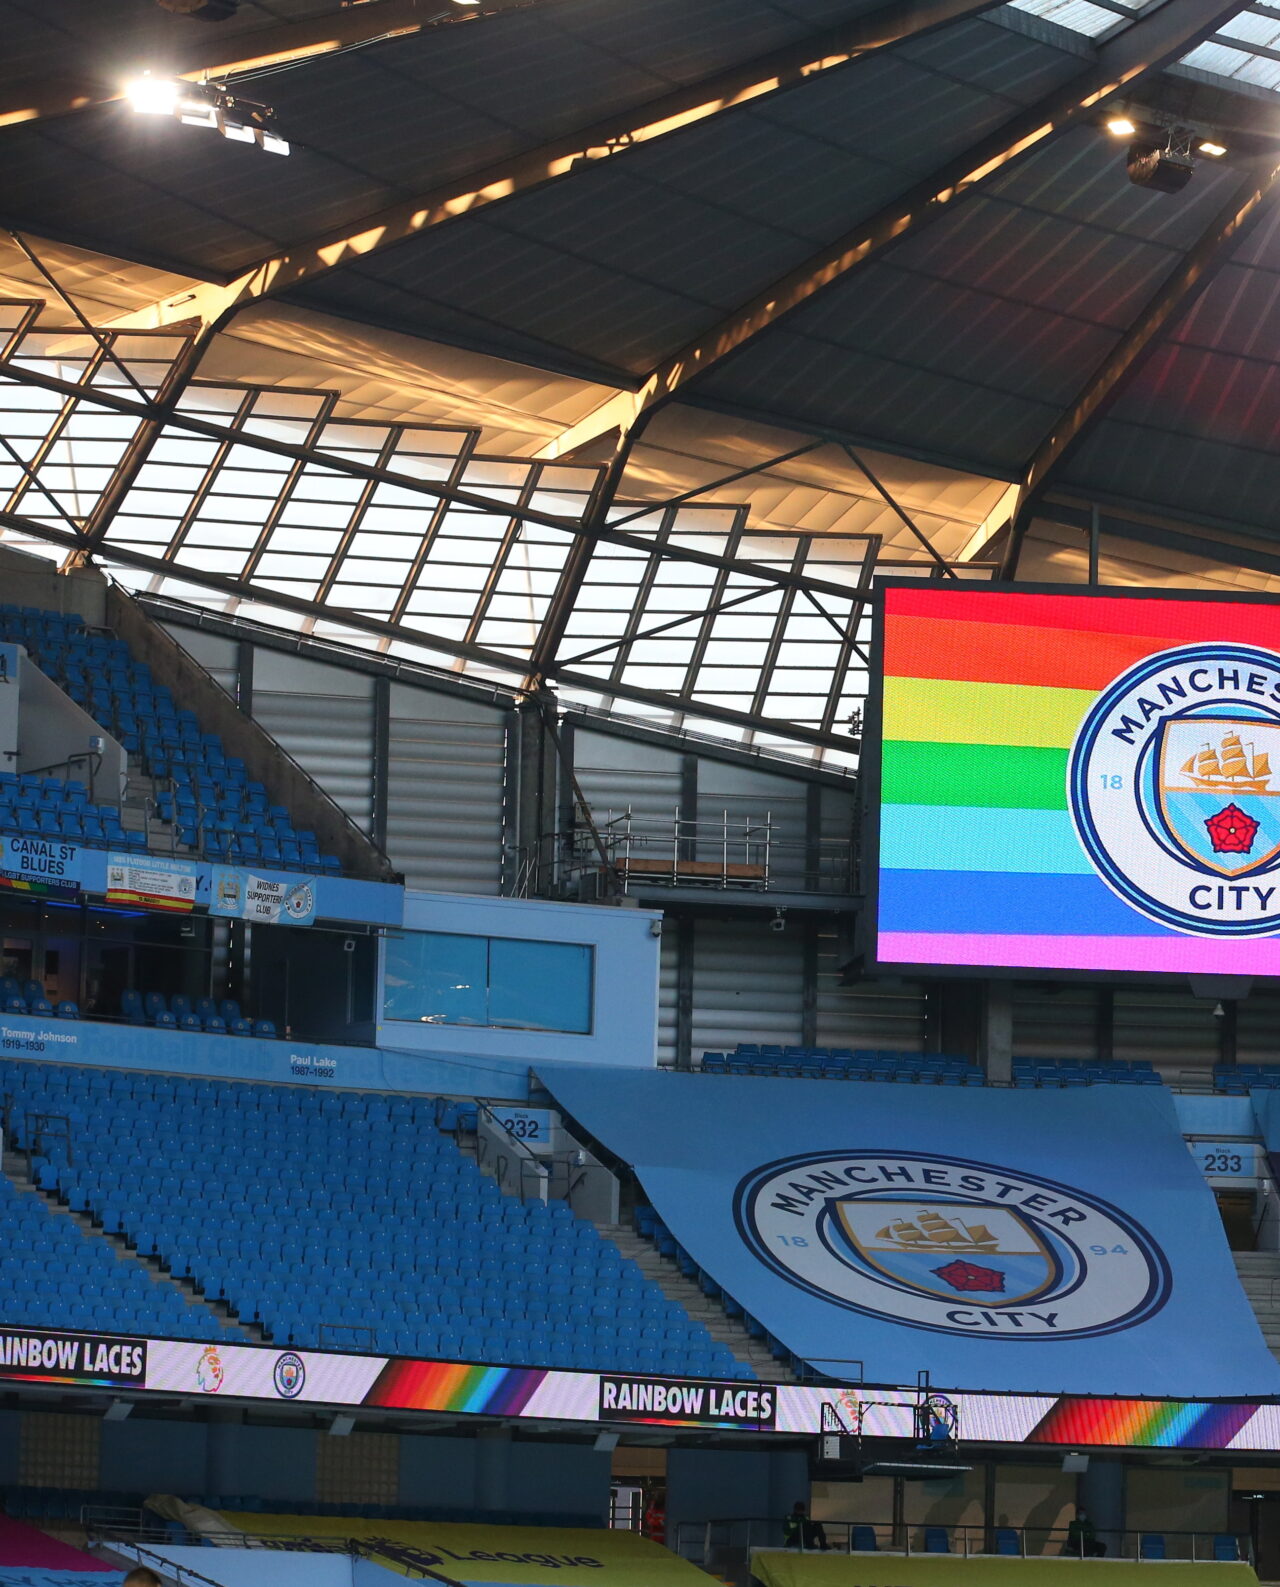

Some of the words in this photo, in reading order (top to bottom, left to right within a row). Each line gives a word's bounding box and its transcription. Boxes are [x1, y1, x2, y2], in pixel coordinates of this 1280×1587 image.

[1100, 773, 1124, 791] 18
[10, 838, 57, 859] CANAL
[59, 846, 76, 861] ST
[21, 856, 65, 875] BLUES
[21, 874, 60, 887] SUPPORTERS
[61, 881, 77, 889] CLUB
[256, 880, 280, 892] WIDNES
[247, 890, 283, 904] SUPPORTERS
[1189, 885, 1277, 911] CITY
[256, 905, 271, 914] CLUB
[1, 1027, 35, 1041] Tommy
[38, 1031, 77, 1043] Johnson
[290, 1054, 311, 1065] Paul
[313, 1056, 337, 1067] Lake
[504, 1119, 539, 1138] 232
[1204, 1154, 1242, 1172] 233
[770, 1165, 1088, 1229] MANCHESTER
[776, 1234, 809, 1249] 18
[1089, 1243, 1129, 1258] 94
[946, 1309, 1059, 1328] CITY
[83, 1342, 143, 1376] LACES
[603, 1382, 704, 1414] RAINBOW
[709, 1389, 772, 1419] LACES
[433, 1545, 605, 1569] League
